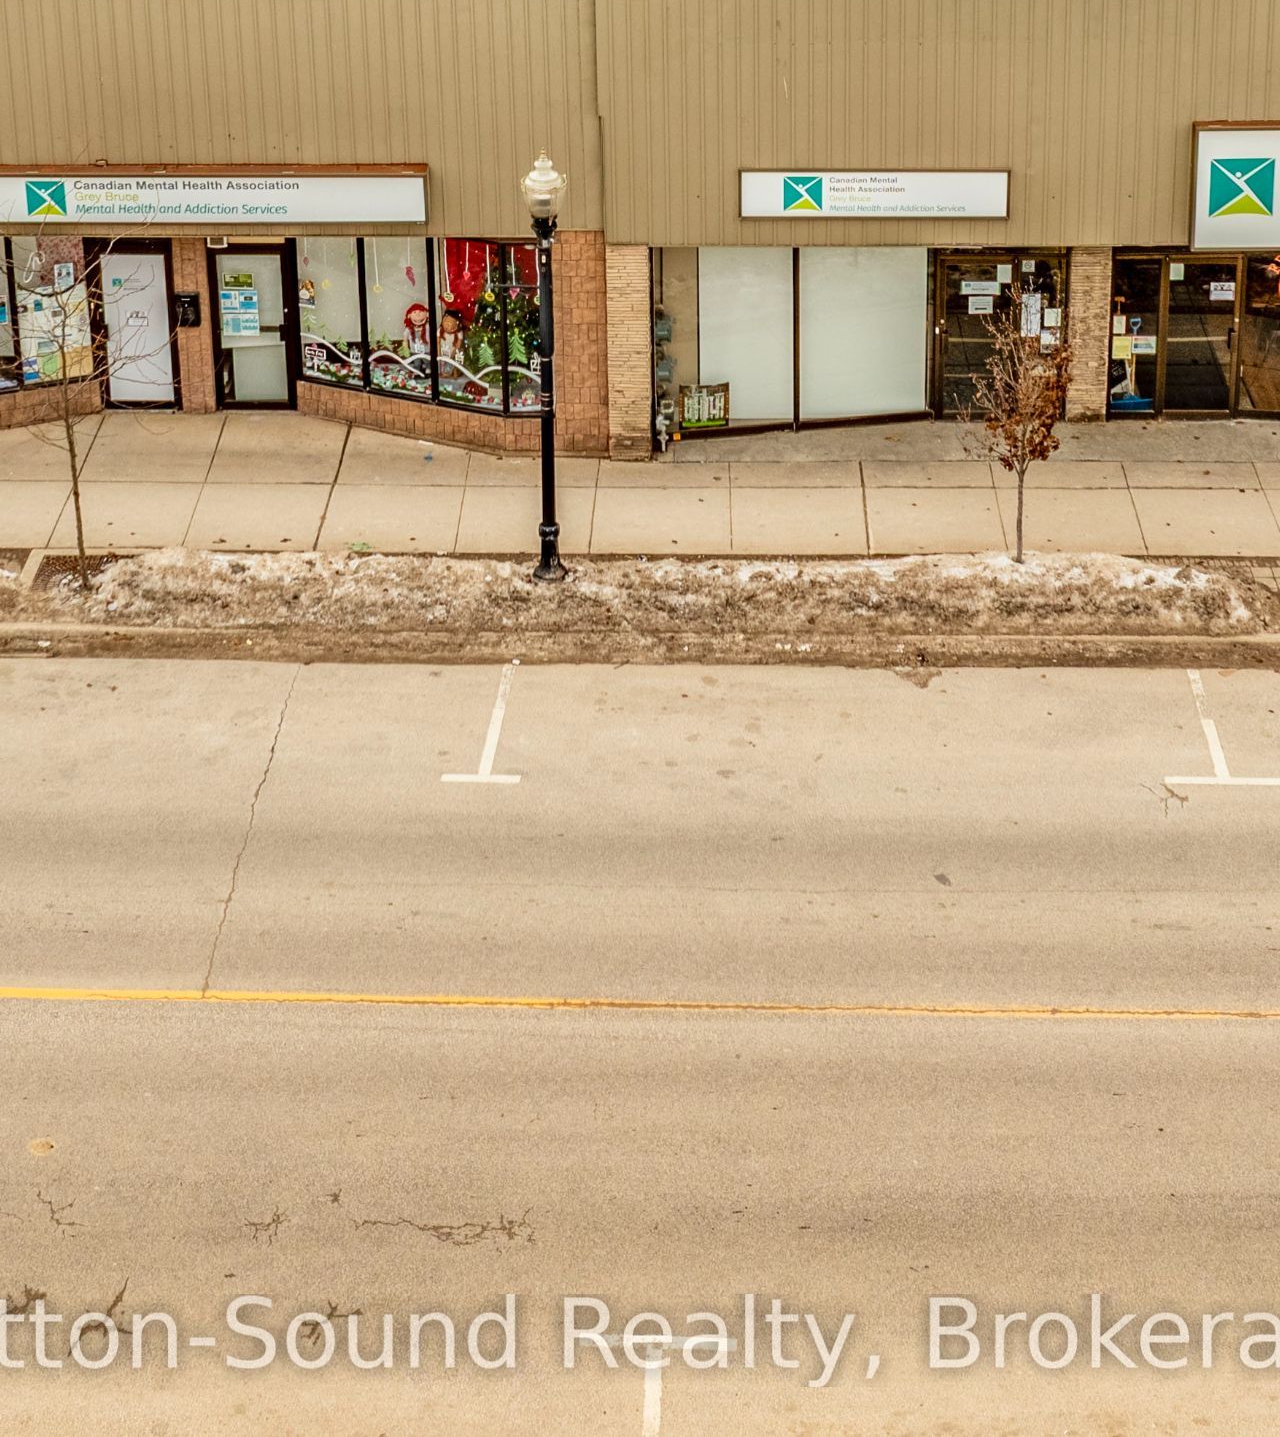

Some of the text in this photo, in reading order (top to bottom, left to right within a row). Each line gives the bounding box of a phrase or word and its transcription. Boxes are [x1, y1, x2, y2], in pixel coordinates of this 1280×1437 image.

[73, 180, 300, 191] Canadian Mental Health Association
[74, 192, 139, 203] Grey Bruce
[75, 204, 287, 215] Mental Health and Addiction Services
[829, 204, 966, 212] Mental Health and Addiction Services
